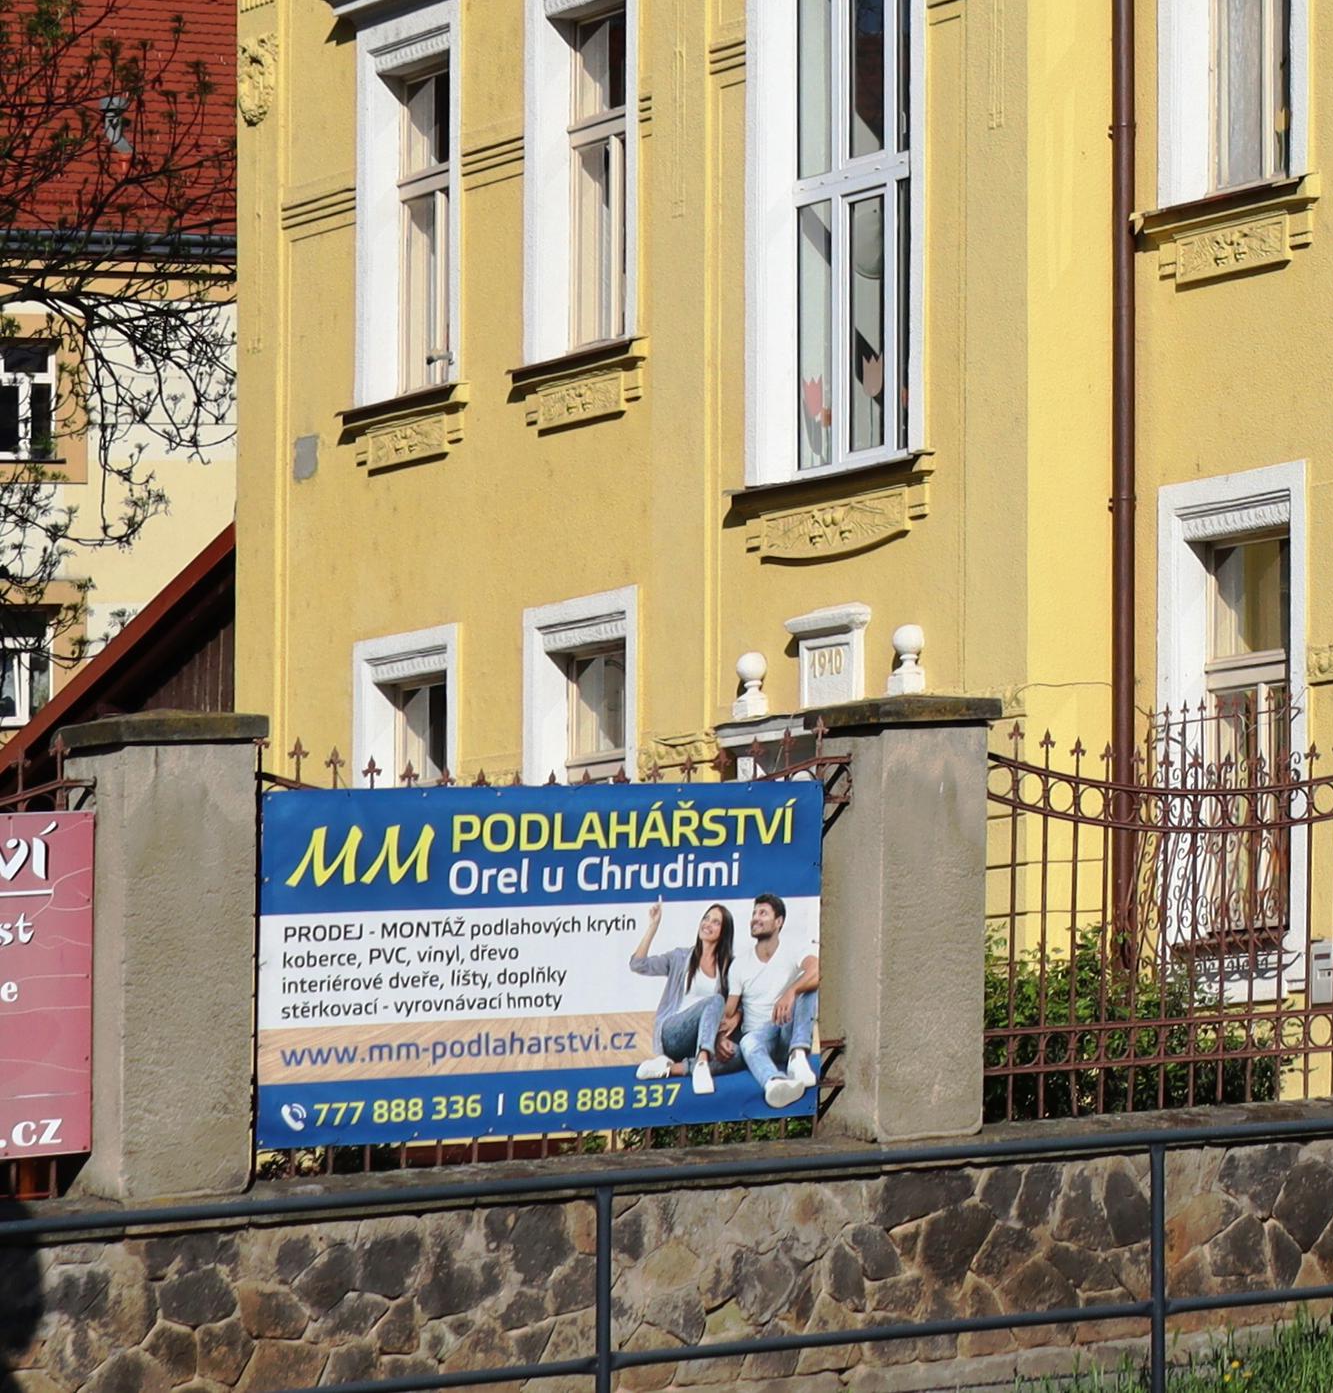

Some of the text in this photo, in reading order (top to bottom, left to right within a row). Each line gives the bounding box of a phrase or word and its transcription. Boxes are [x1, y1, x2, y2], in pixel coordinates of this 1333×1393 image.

[810, 647, 844, 678] 1910
[453, 798, 797, 853] PODLAHÁŘSTVÍ
[285, 824, 435, 887] MM
[449, 852, 741, 896] Orel u Chrudimi
[283, 923, 365, 943] PRODEJ
[380, 917, 466, 940] MONTÁŽ
[470, 916, 581, 940] podlahových
[586, 915, 637, 936] krytin
[282, 944, 520, 969] koberce, PVC, vinyl, dřevo
[281, 966, 568, 995] interiérové dveře, lišty, doplňky
[280, 999, 379, 1021] stěrkovací
[393, 992, 502, 1018] vyrovnávací
[505, 992, 563, 1012] hmoty
[280, 1027, 638, 1068] www.mm-podlaharstvi.cz
[313, 1100, 366, 1128] 777
[372, 1097, 424, 1124] 888
[431, 1093, 484, 1121] 336
[519, 1089, 569, 1116] 608
[576, 1086, 626, 1112] 888
[632, 1083, 682, 1109] 337
